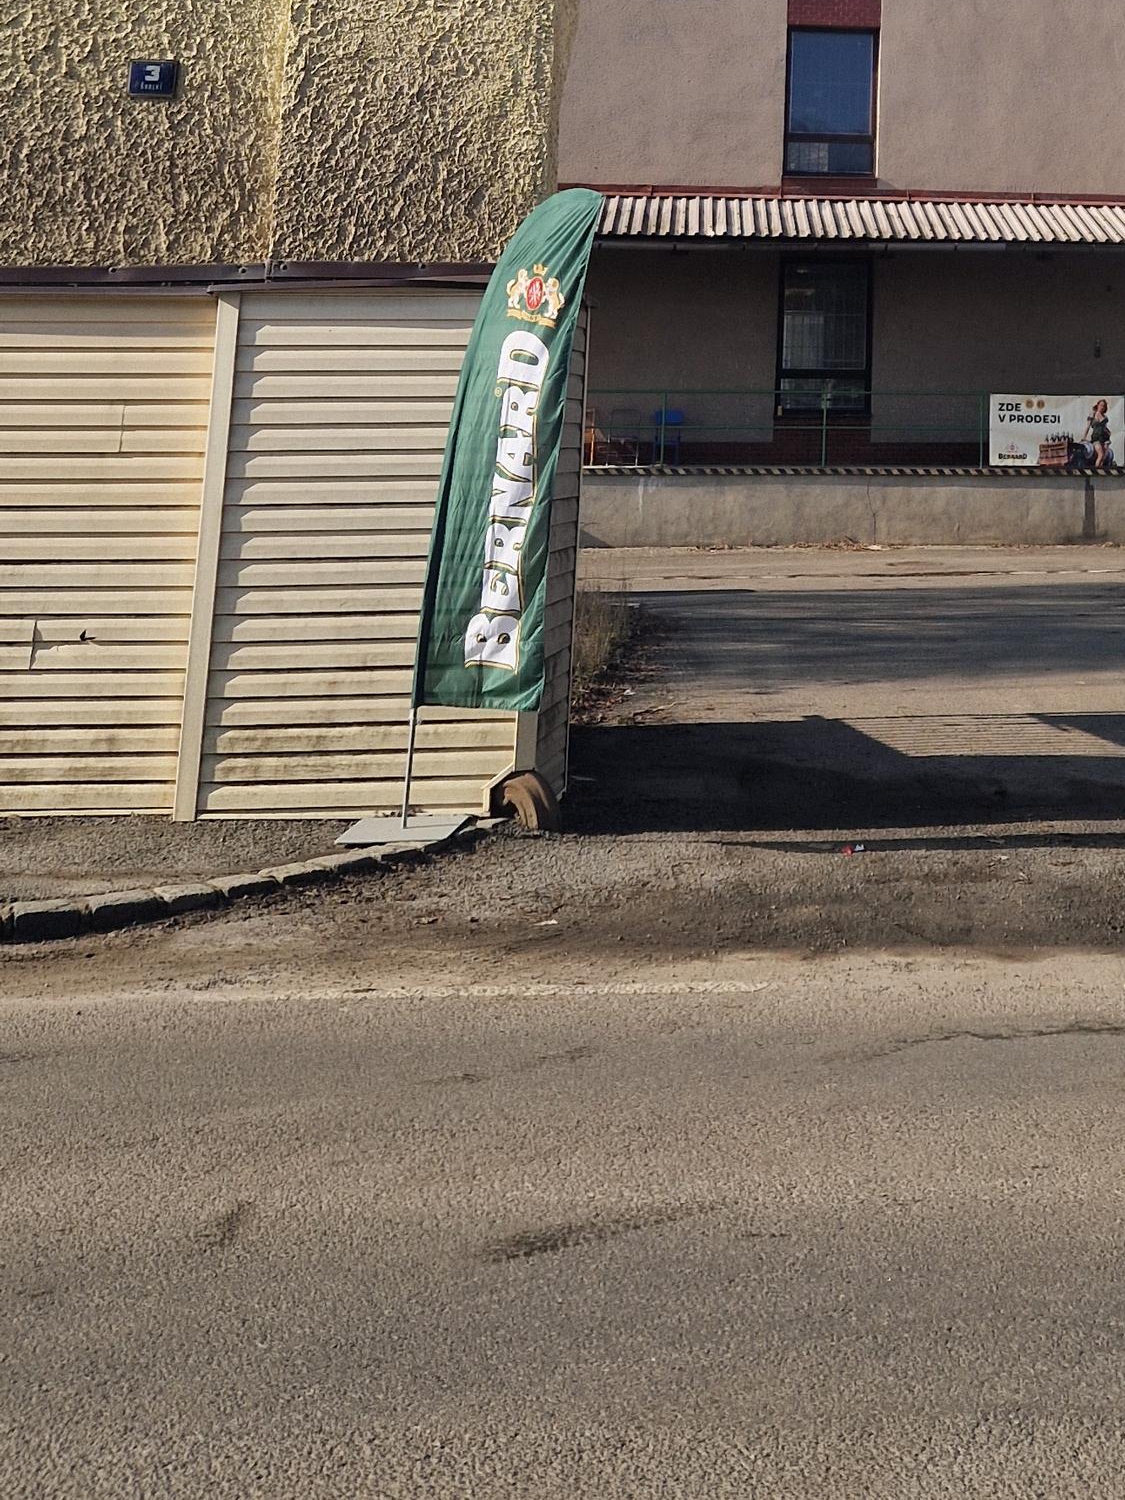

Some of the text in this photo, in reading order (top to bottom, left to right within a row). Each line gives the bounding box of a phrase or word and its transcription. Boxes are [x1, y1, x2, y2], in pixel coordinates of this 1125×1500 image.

[145, 65, 161, 82] 3
[998, 402, 1022, 412] ZDE
[998, 414, 1061, 424] V PRODEJI
[464, 330, 550, 676] BERNARD
